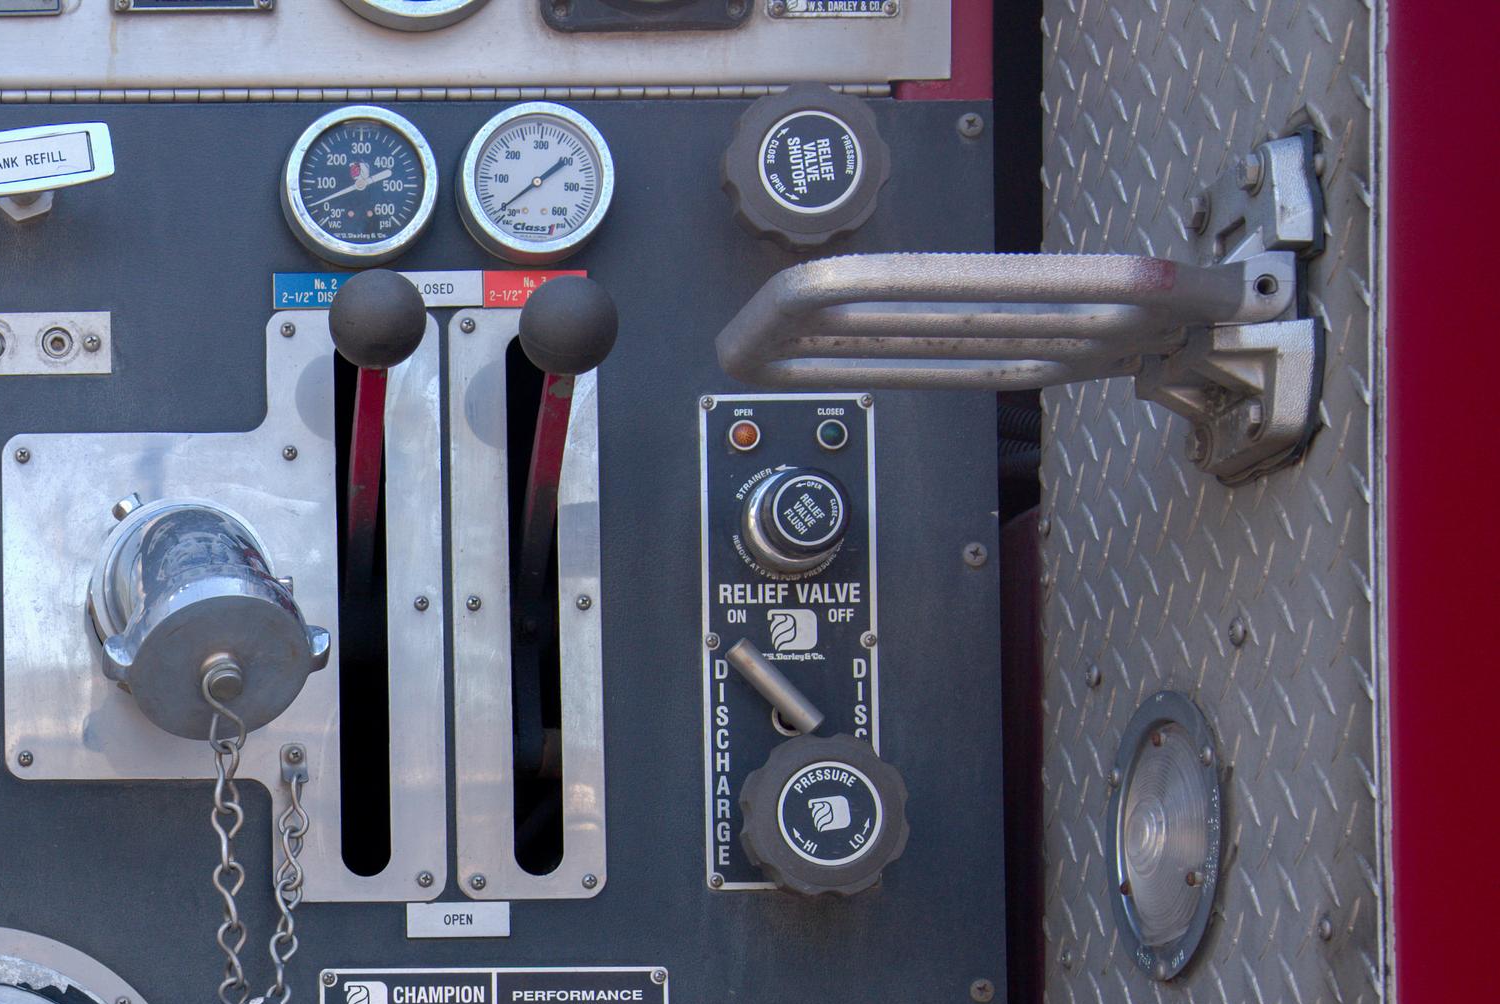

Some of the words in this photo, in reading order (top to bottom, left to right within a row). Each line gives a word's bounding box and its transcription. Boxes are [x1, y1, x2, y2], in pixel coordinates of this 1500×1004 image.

[828, 0, 858, 11] DARLEY
[861, 0, 867, 11] &
[869, 0, 882, 11] CO.
[351, 142, 371, 154] 300
[841, 134, 855, 175] PRESSURE
[25, 149, 66, 166] REFILL
[327, 154, 347, 166] 200
[374, 156, 394, 168] 400
[787, 137, 807, 194] SHUTOFF
[802, 141, 820, 182] VALVE
[816, 138, 835, 181] RELIEF
[317, 177, 336, 189] 100
[383, 180, 403, 192] 500
[374, 203, 395, 215] 600
[734, 408, 753, 417] OPEN
[817, 407, 845, 416] CLOSED
[735, 467, 772, 500] STRAINER
[793, 501, 816, 528] VALVE
[800, 493, 826, 520] RELIEF
[783, 508, 808, 535] FLUSH
[719, 584, 789, 604] RELIEF
[795, 583, 860, 603] VALVE
[727, 609, 746, 623] ON
[828, 608, 854, 622] OFF
[715, 659, 731, 866] DISCHARGE
[793, 769, 857, 794] PRESSURE
[802, 839, 818, 854] HI
[849, 833, 865, 850] LO
[443, 914, 473, 925] OPEN
[393, 986, 485, 1003] CHAMPION
[512, 990, 643, 1001] PERFORMANCE
